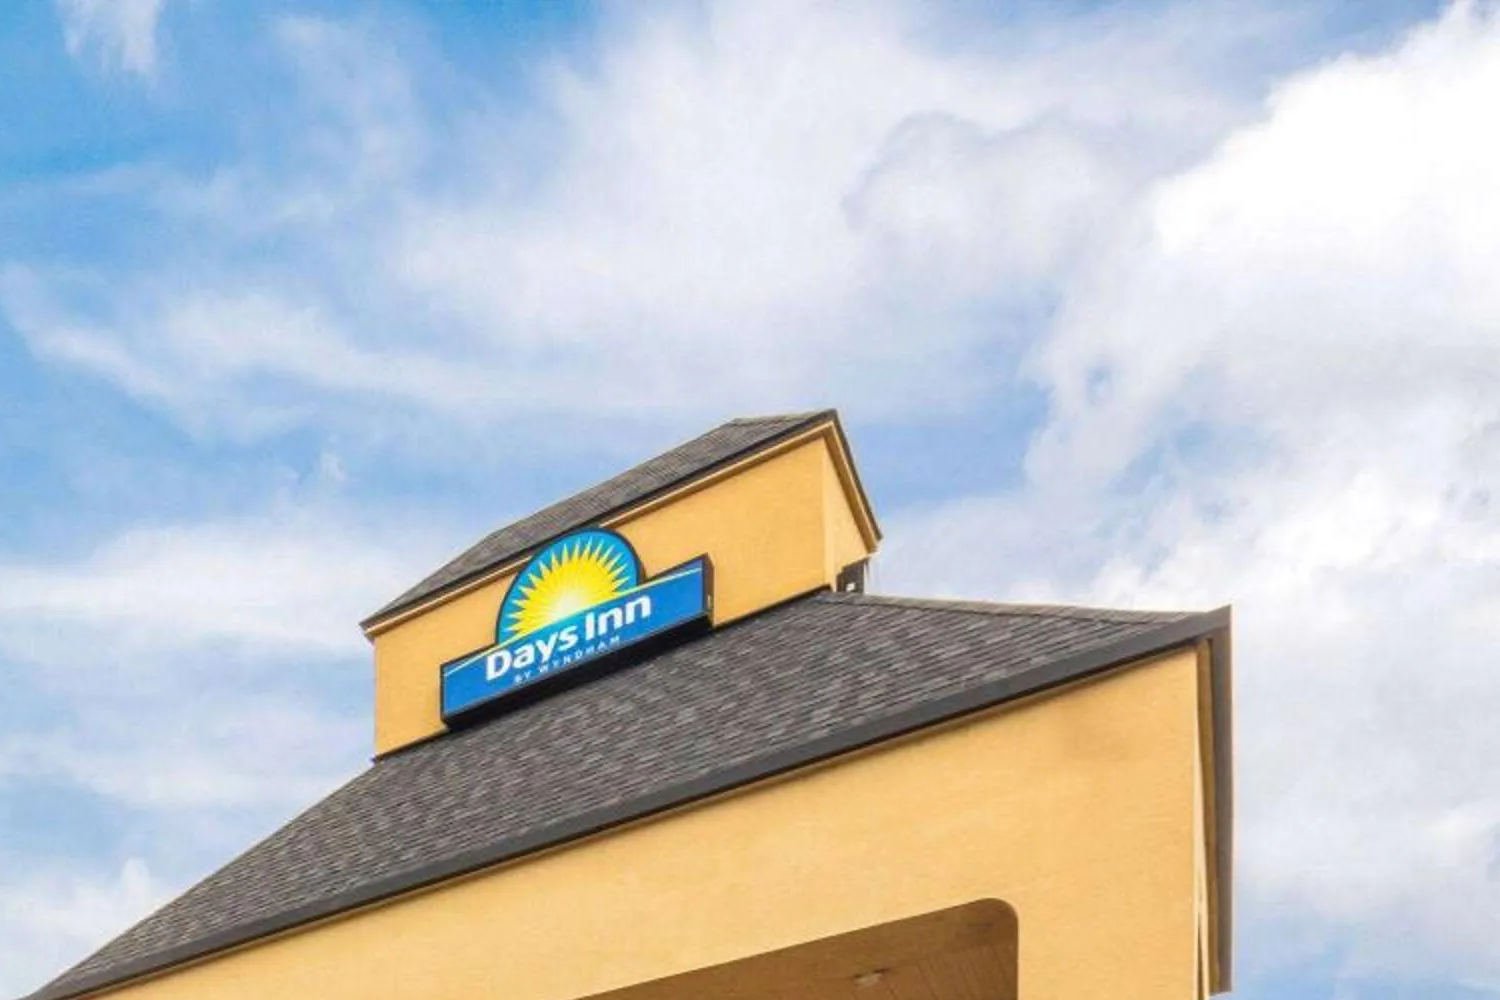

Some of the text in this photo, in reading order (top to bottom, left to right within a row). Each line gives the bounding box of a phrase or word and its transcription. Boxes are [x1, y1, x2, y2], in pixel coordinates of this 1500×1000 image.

[486, 595, 652, 681] Days Inn
[513, 635, 621, 685] BY WYNDHAM
